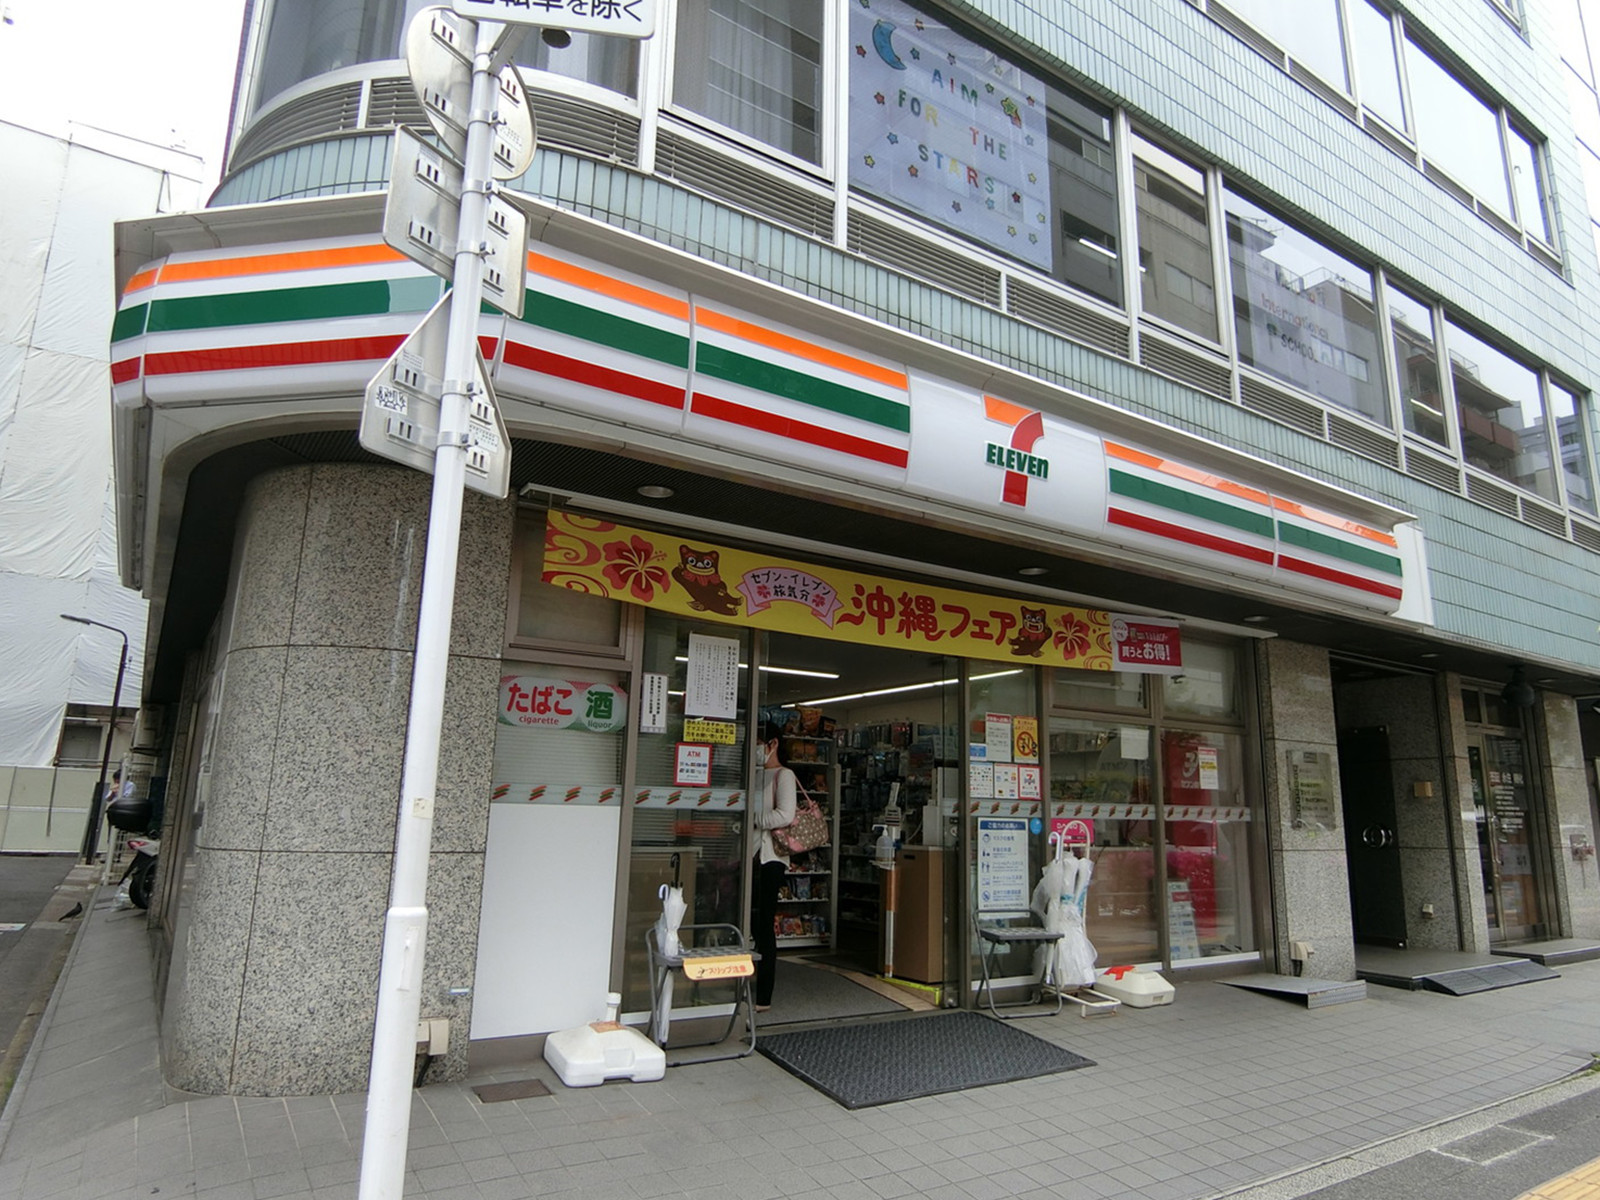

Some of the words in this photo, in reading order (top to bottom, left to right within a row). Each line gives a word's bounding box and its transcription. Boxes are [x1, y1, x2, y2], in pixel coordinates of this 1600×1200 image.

[465, 0, 642, 22] を除く
[931, 68, 979, 107] AIM
[898, 88, 938, 127] FOR
[968, 126, 1007, 161] THE
[918, 143, 995, 195] STARS
[773, 585, 811, 602] 旅気分
[507, 683, 573, 715] たばこ
[585, 689, 614, 719] 酒
[518, 715, 560, 726] cigarette
[587, 719, 613, 730] liquor
[687, 750, 701, 758] ATM
